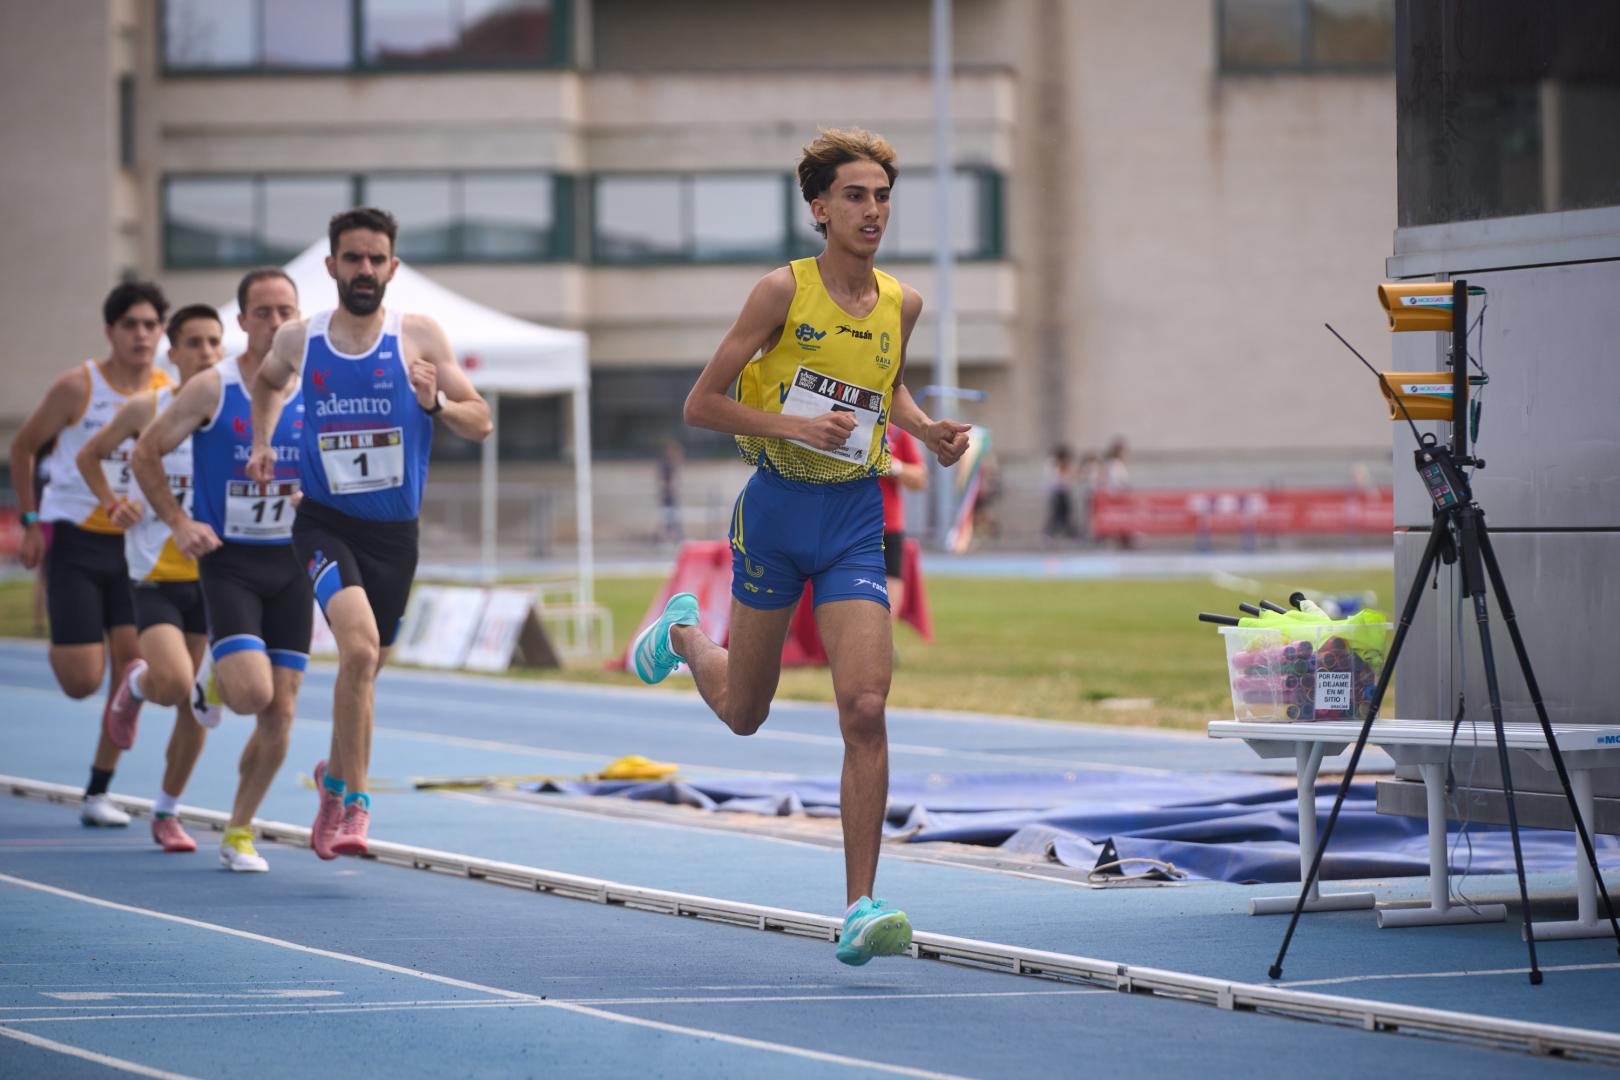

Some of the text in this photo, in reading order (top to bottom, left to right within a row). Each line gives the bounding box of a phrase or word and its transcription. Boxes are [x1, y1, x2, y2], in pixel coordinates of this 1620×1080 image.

[819, 378, 860, 404] A4XKM
[316, 392, 392, 416] adentro
[353, 452, 368, 477] 1
[252, 499, 286, 523] 11
